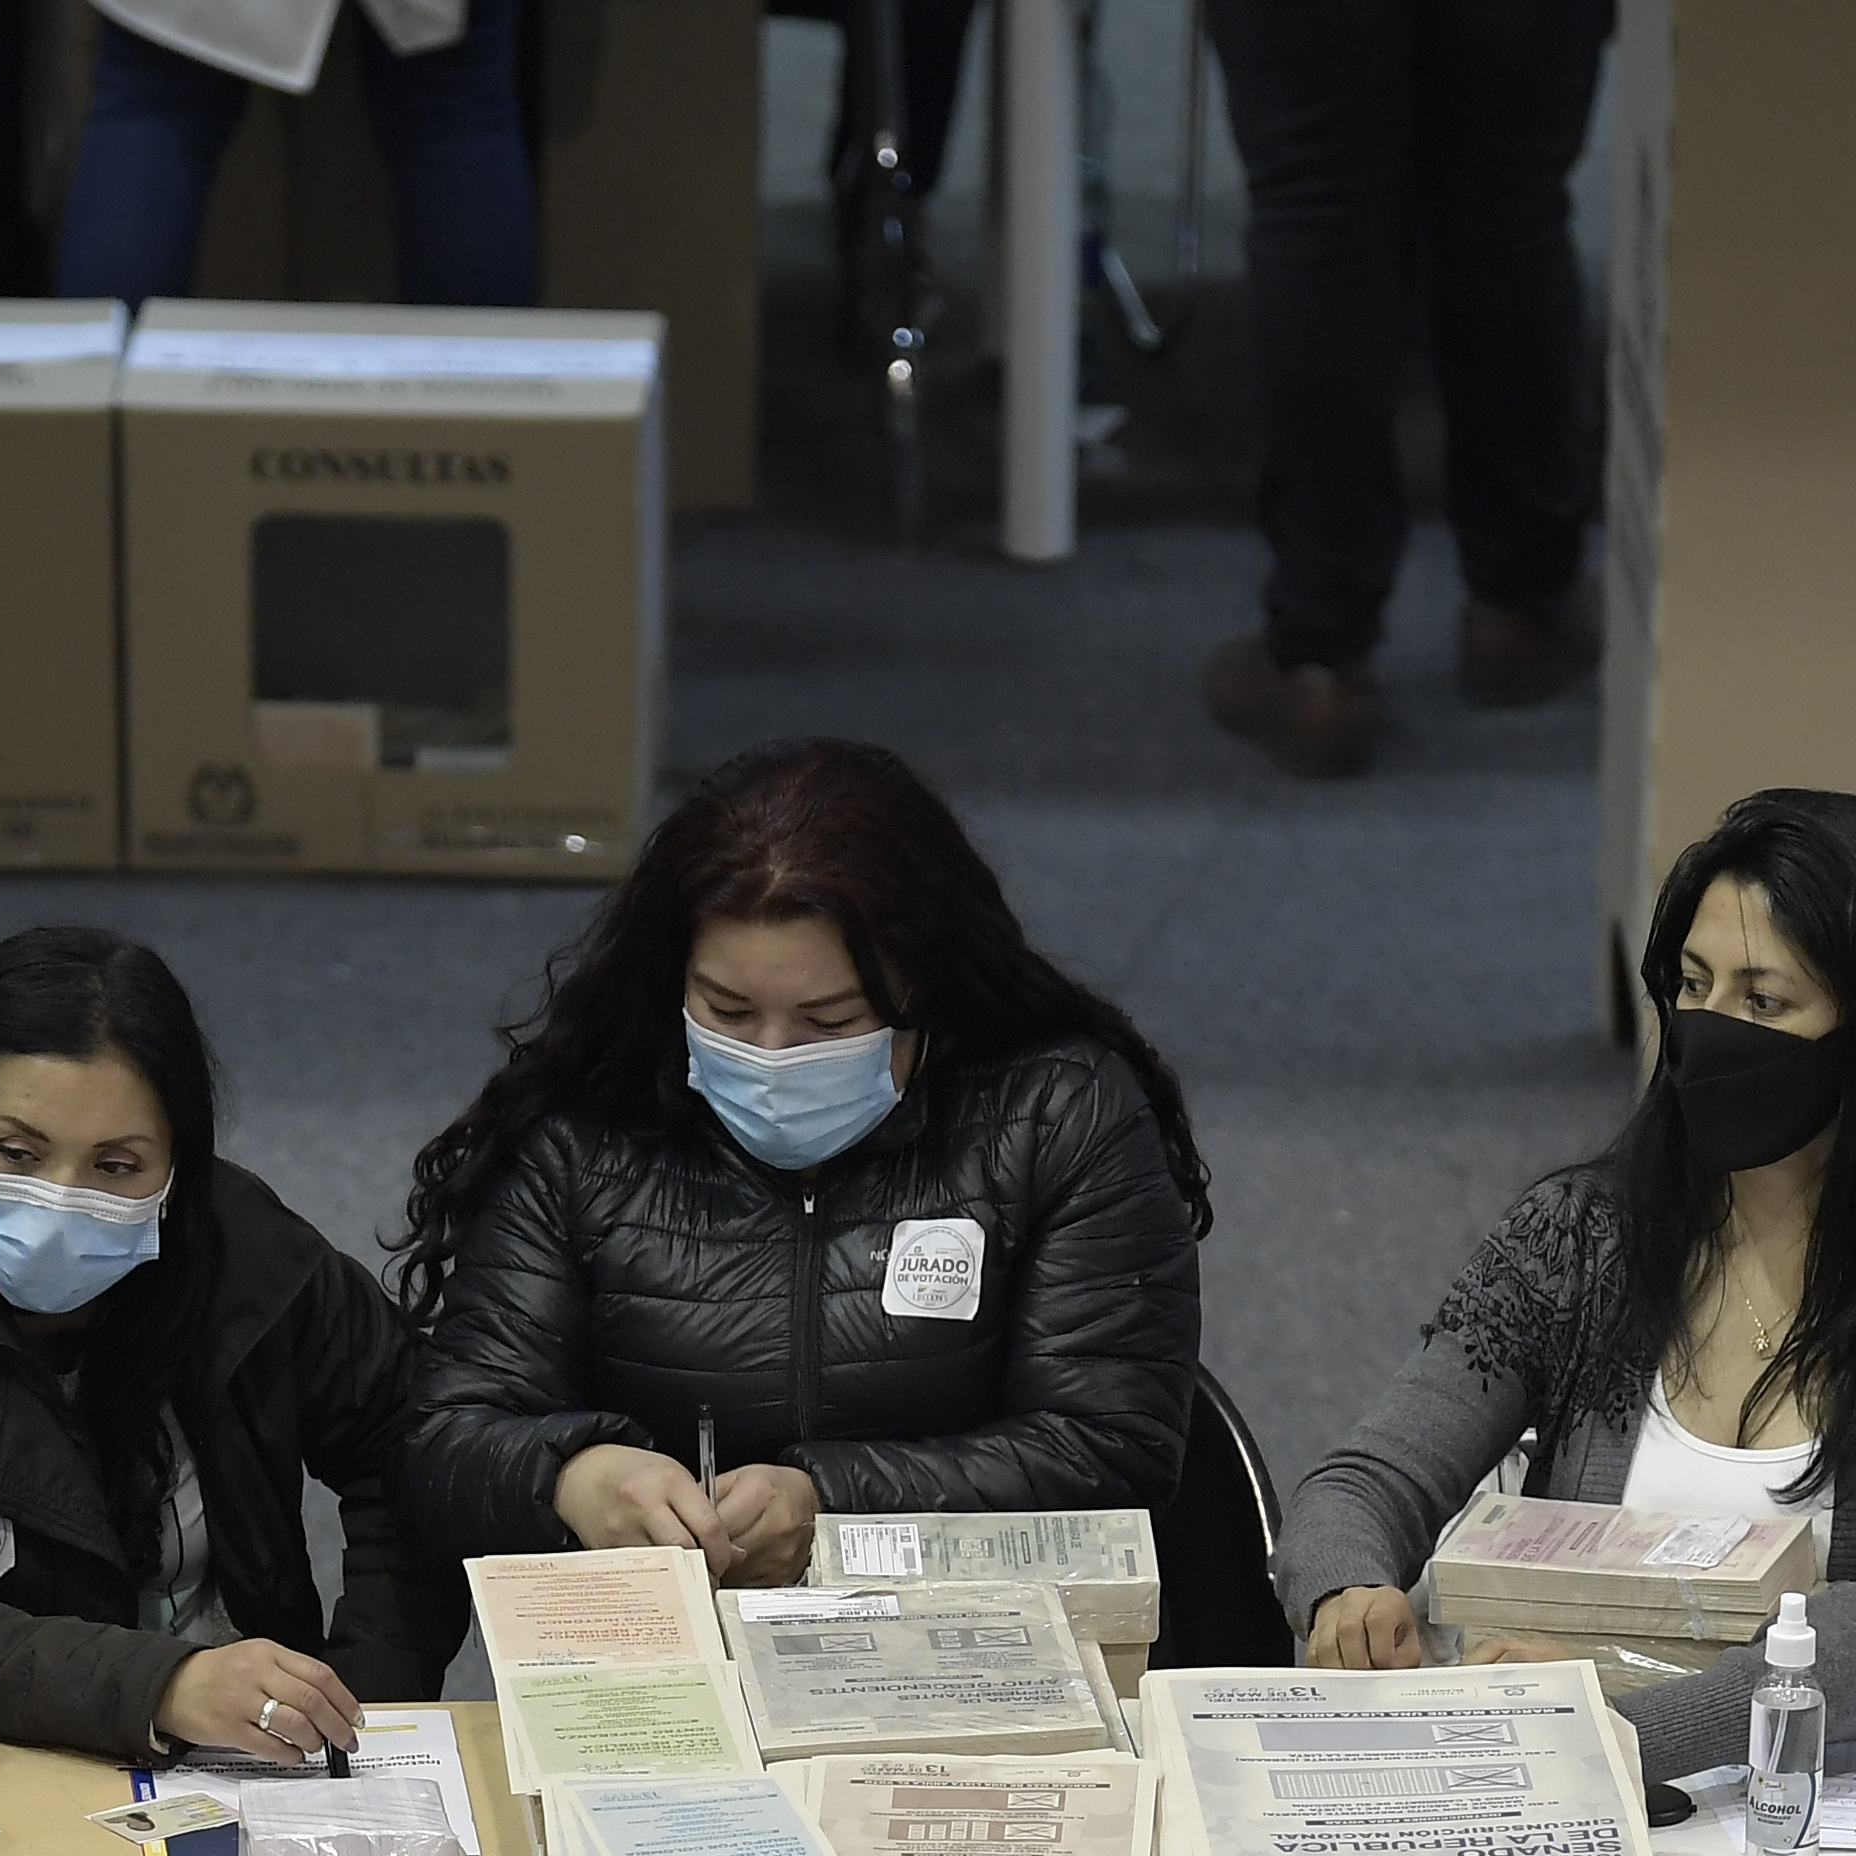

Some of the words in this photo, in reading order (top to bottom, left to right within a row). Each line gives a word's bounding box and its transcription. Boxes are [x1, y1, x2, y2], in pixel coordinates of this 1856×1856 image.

[248, 445, 512, 486] CONSULTAS
[899, 1258, 969, 1274] JURADO
[898, 1274, 910, 1282] DE
[913, 1274, 968, 1285] VOTACIÓN
[1288, 1685, 1320, 1697] 13
[924, 1763, 947, 1773] 13
[1749, 1795, 1801, 1814] ALCOHOL
[1397, 1817, 1615, 1838] CIRCUNSCRIPCIÓN
[1567, 1826, 1619, 1840] DE
[1269, 1828, 1389, 1842] NACIONAL
[1504, 1832, 1553, 1844] LA
[1271, 1834, 1492, 1856] REPÚBLICA
